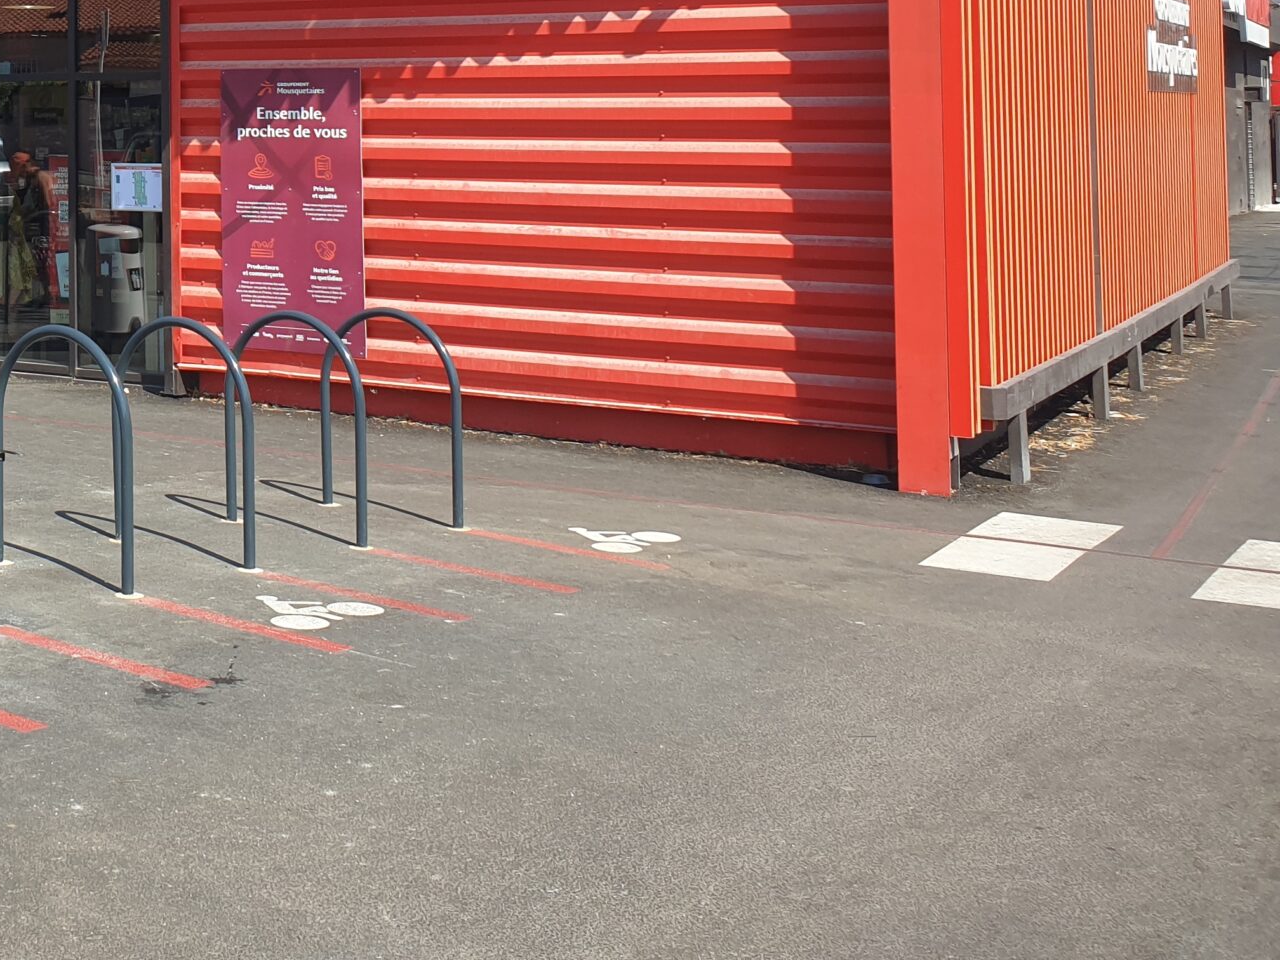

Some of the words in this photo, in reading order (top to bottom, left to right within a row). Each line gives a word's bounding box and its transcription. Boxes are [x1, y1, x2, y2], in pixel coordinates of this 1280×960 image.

[276, 87, 325, 96] Mousquetaires
[256, 107, 326, 123] Ensemble,
[237, 125, 290, 141] proches
[293, 125, 311, 138] de
[313, 128, 347, 139] vous
[246, 263, 280, 271] Producteurs
